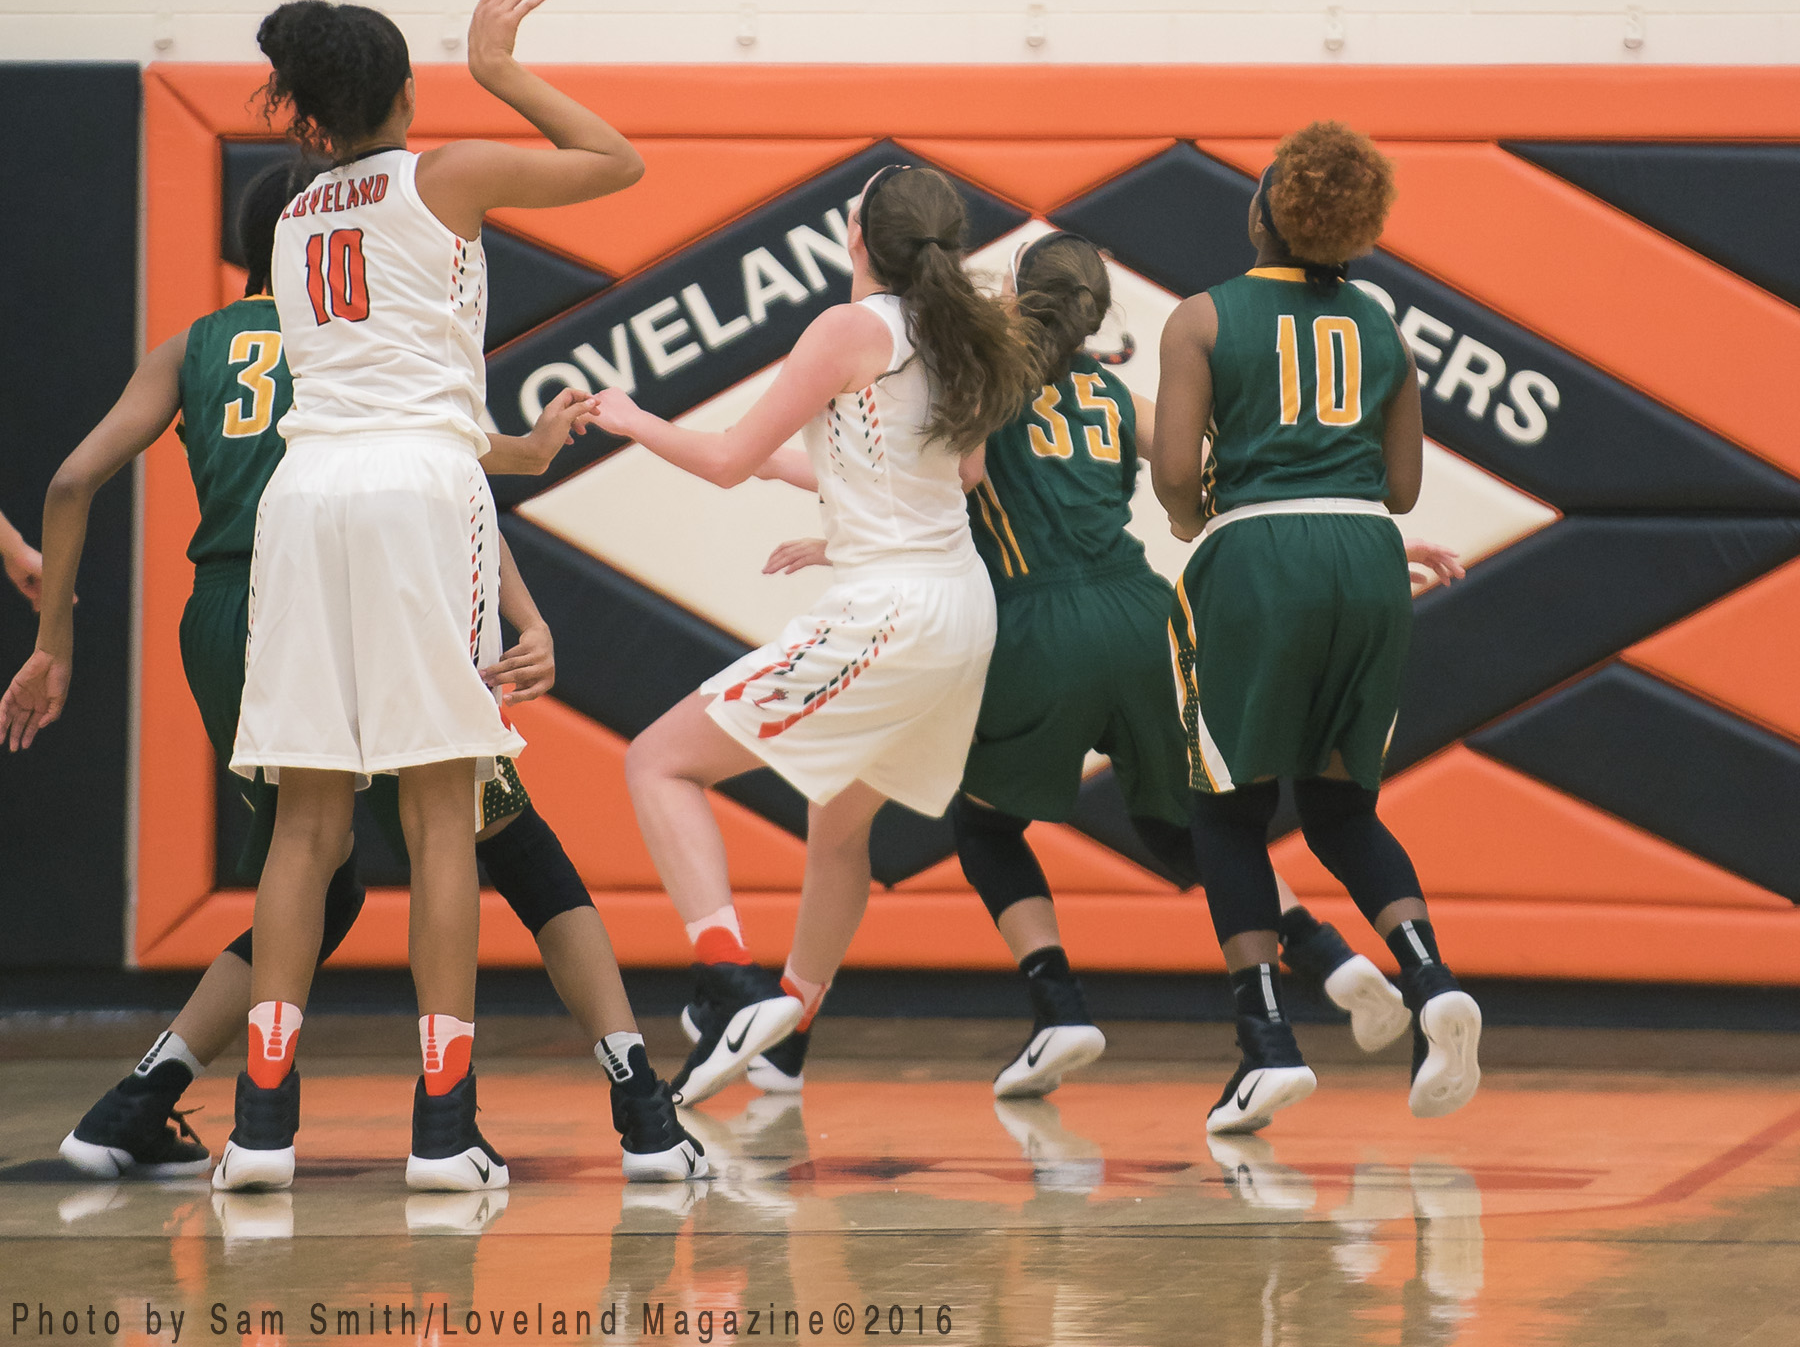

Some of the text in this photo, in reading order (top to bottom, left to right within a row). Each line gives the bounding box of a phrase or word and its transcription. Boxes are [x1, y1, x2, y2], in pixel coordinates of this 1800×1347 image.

[282, 173, 389, 220] LOVELAND
[305, 228, 371, 327] 10
[484, 193, 861, 437] OVELAN
[1027, 372, 1122, 463] 35
[1276, 315, 1362, 427] 10
